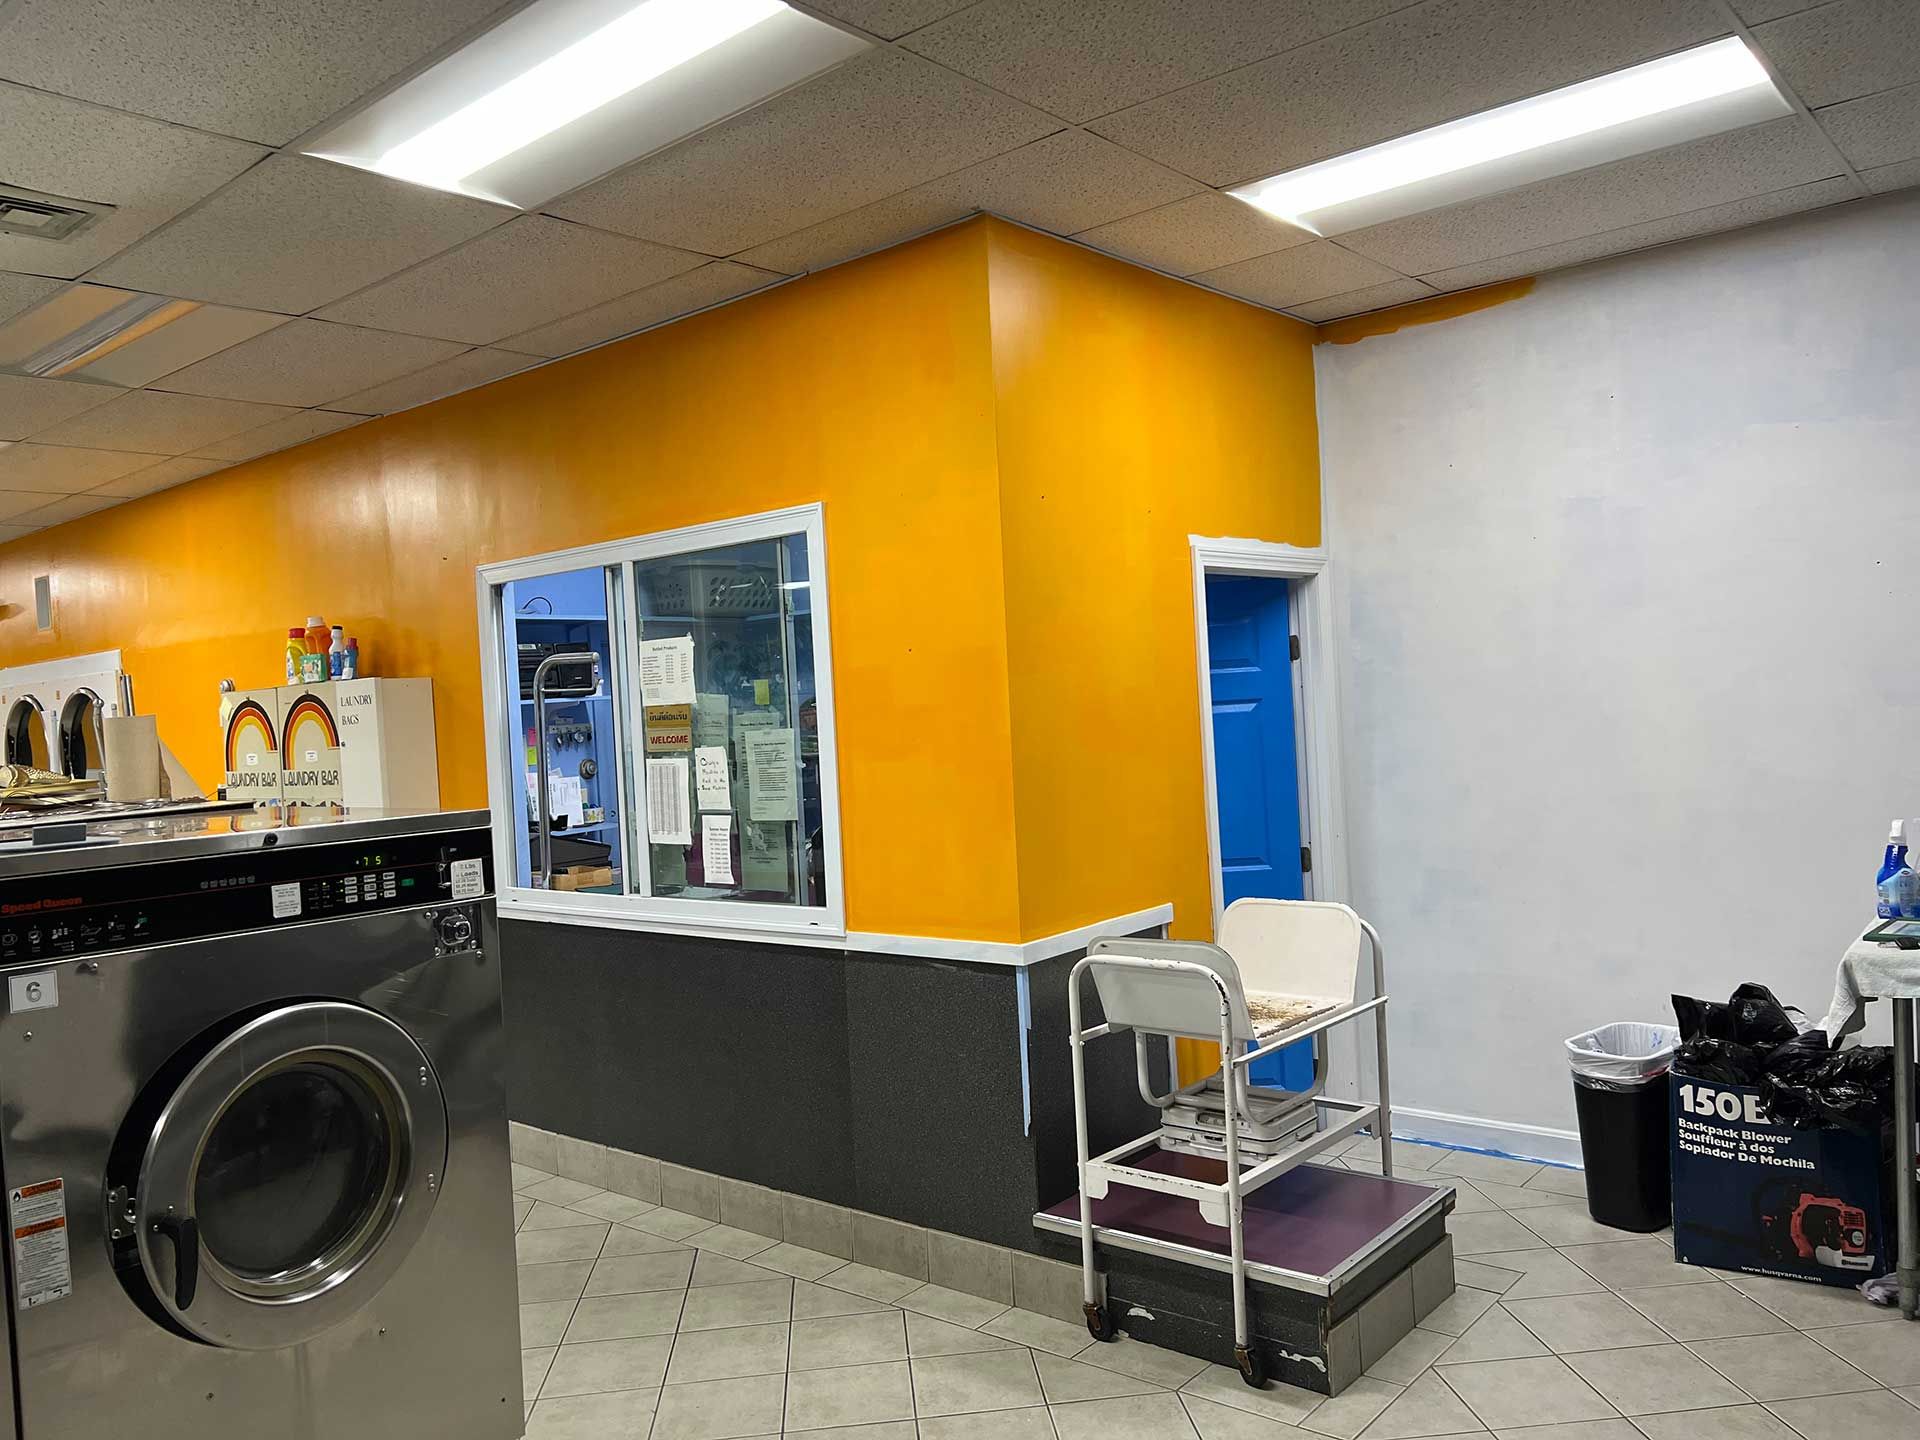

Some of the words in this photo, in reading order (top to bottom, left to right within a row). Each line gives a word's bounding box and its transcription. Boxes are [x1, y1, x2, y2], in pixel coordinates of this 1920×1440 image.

[341, 694, 373, 707] LAUNDRY
[342, 714, 360, 725] BAGS
[650, 735, 689, 744] WELCOME
[226, 773, 260, 787] LAUNDRY
[261, 772, 278, 787] BAR
[283, 771, 320, 786] LAUNDRY
[321, 770, 339, 786] BAR
[1, 900, 41, 914] Speed
[25, 981, 42, 1003] 6
[1678, 1117, 1740, 1139] Backpack
[1741, 1130, 1792, 1145] Blower
[1678, 1129, 1736, 1149] Souffleur
[1739, 1140, 1747, 1151] à
[1749, 1143, 1775, 1154] dos
[1679, 1139, 1735, 1160] Soplador
[1738, 1152, 1757, 1163] De
[1760, 1154, 1816, 1170] Mochila
[1741, 1265, 1822, 1283] www.husqvarna.com
